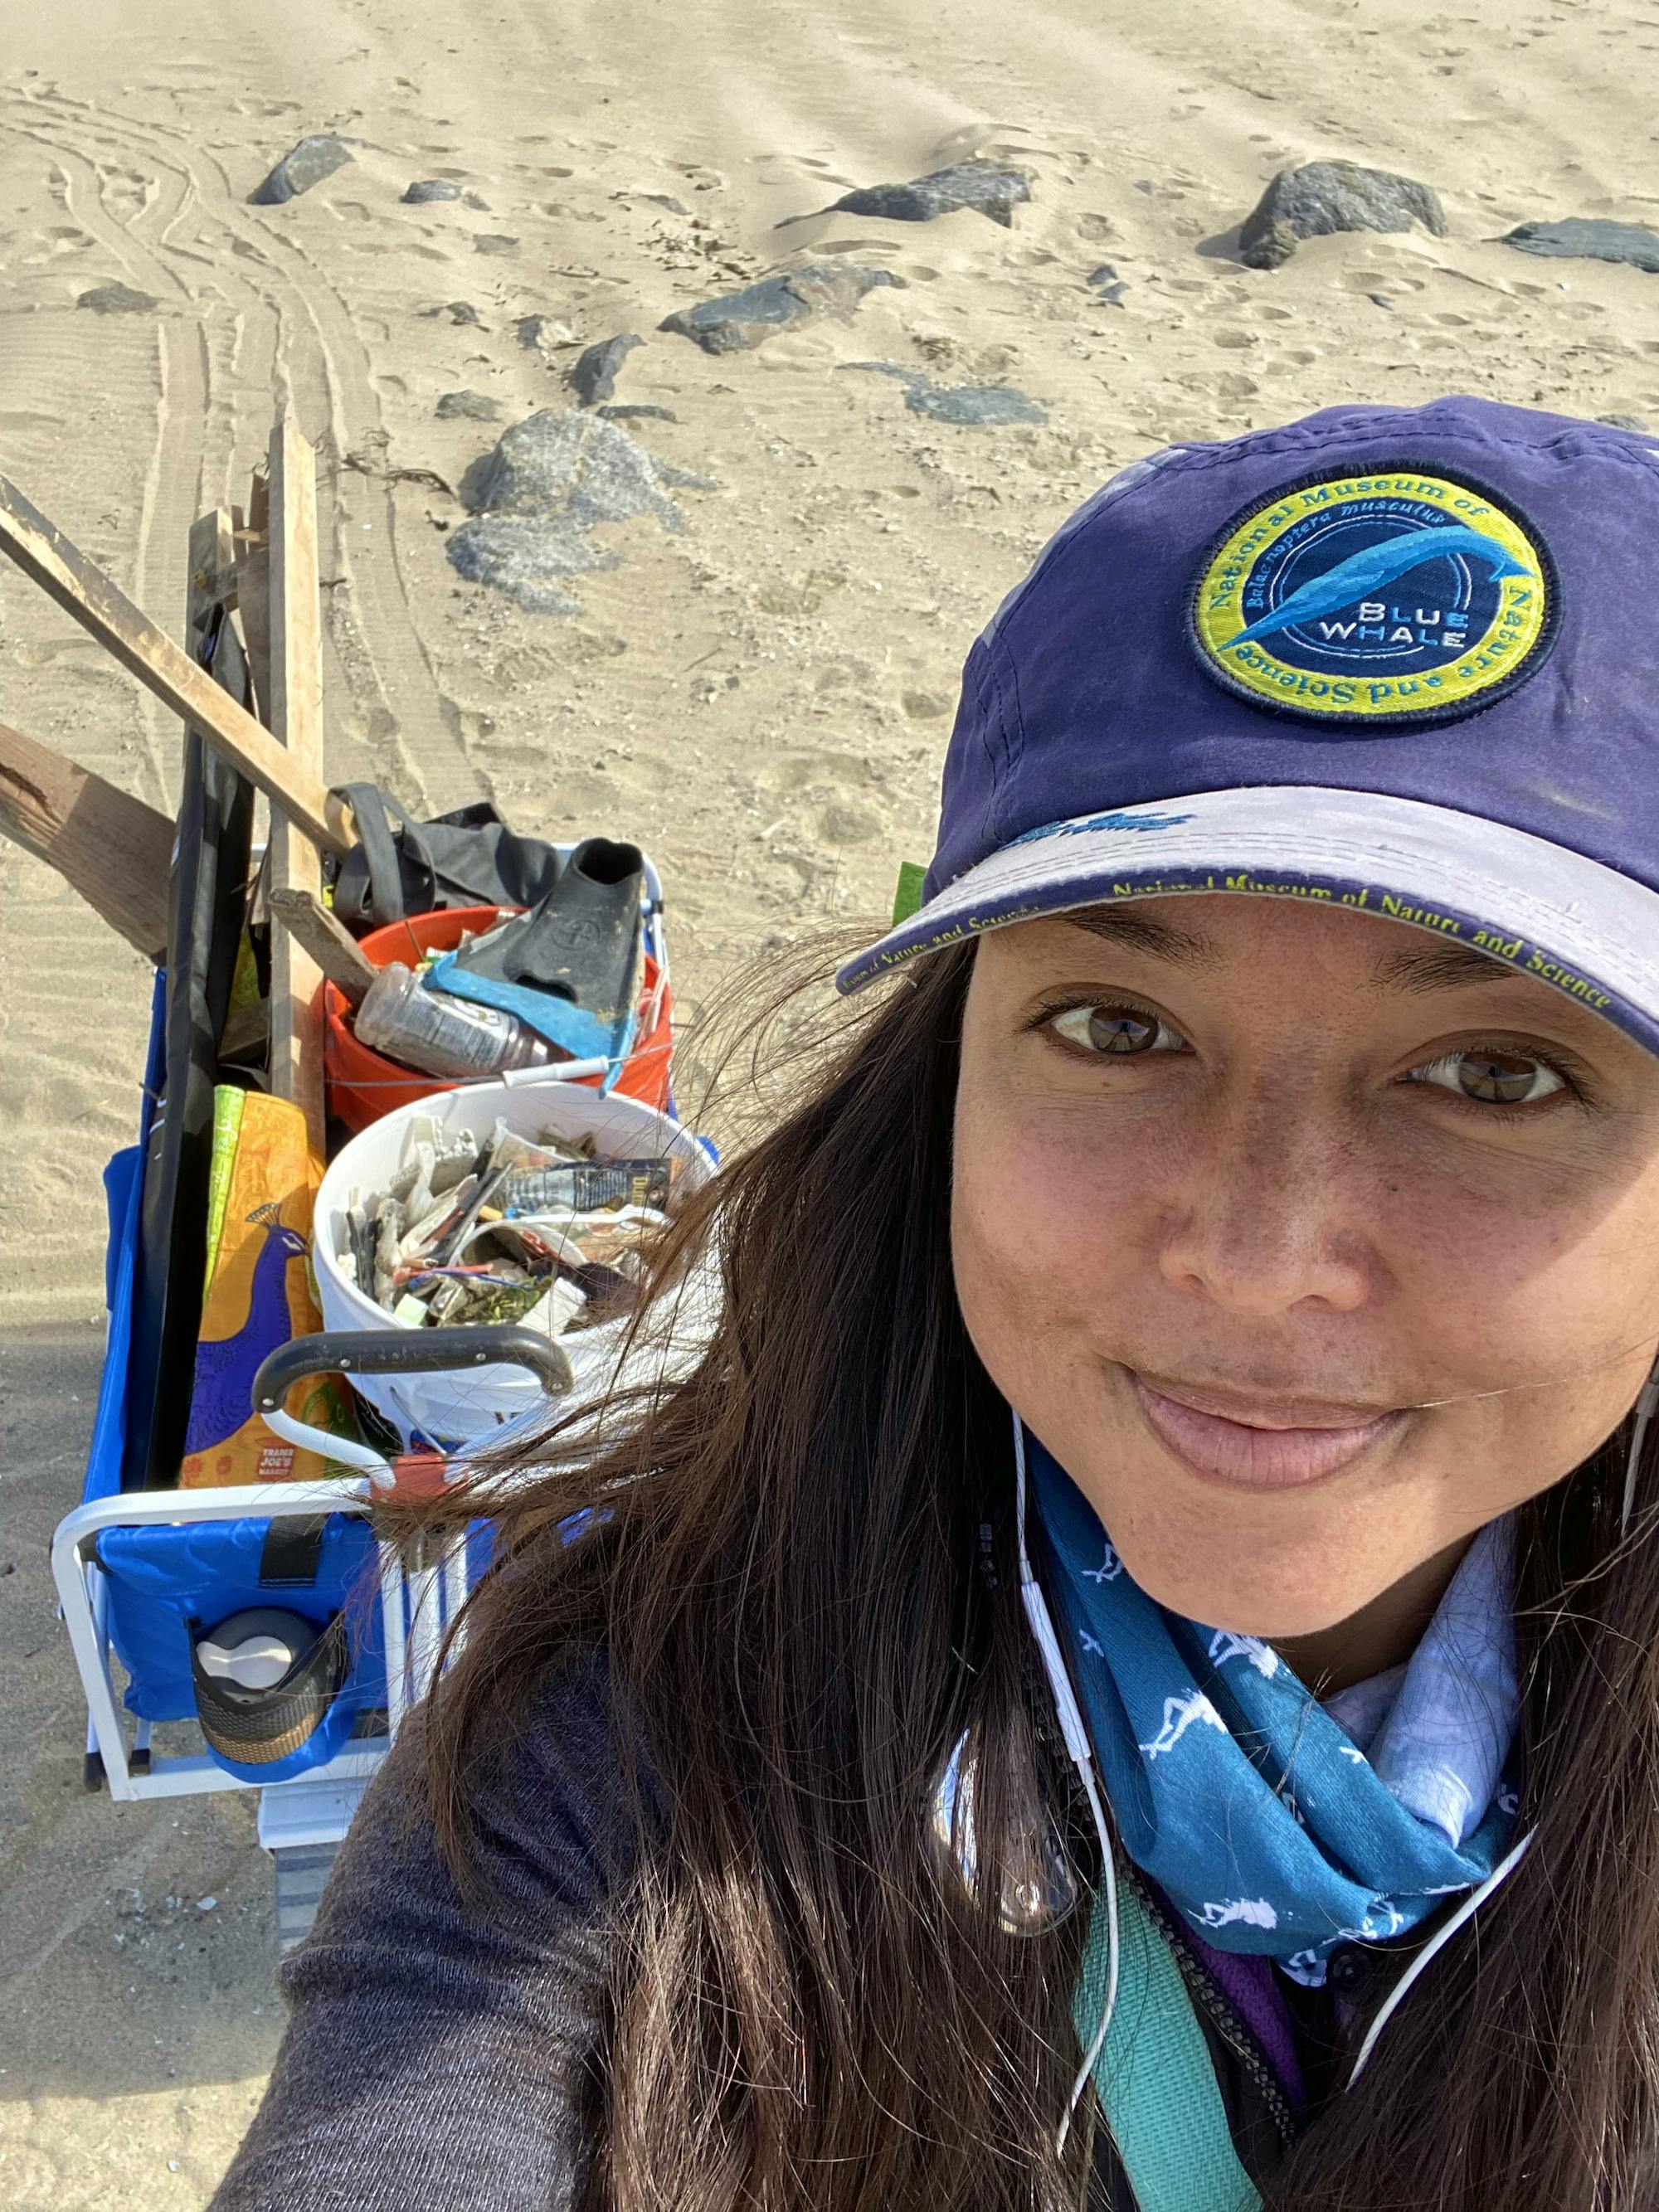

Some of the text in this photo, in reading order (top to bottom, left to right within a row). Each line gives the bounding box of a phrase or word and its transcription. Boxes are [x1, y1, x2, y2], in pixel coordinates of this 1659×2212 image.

[1340, 499, 1446, 523] musculus
[1210, 479, 1533, 704] National Museum of Nature and Science
[1359, 602, 1469, 634] BLUE
[1319, 621, 1467, 648] WHALE
[1341, 888, 1369, 907] of
[1381, 893, 1461, 933] Nature
[1472, 929, 1524, 959] and
[1525, 950, 1612, 1009] Science
[260, 1457, 293, 1466] JOE'S
